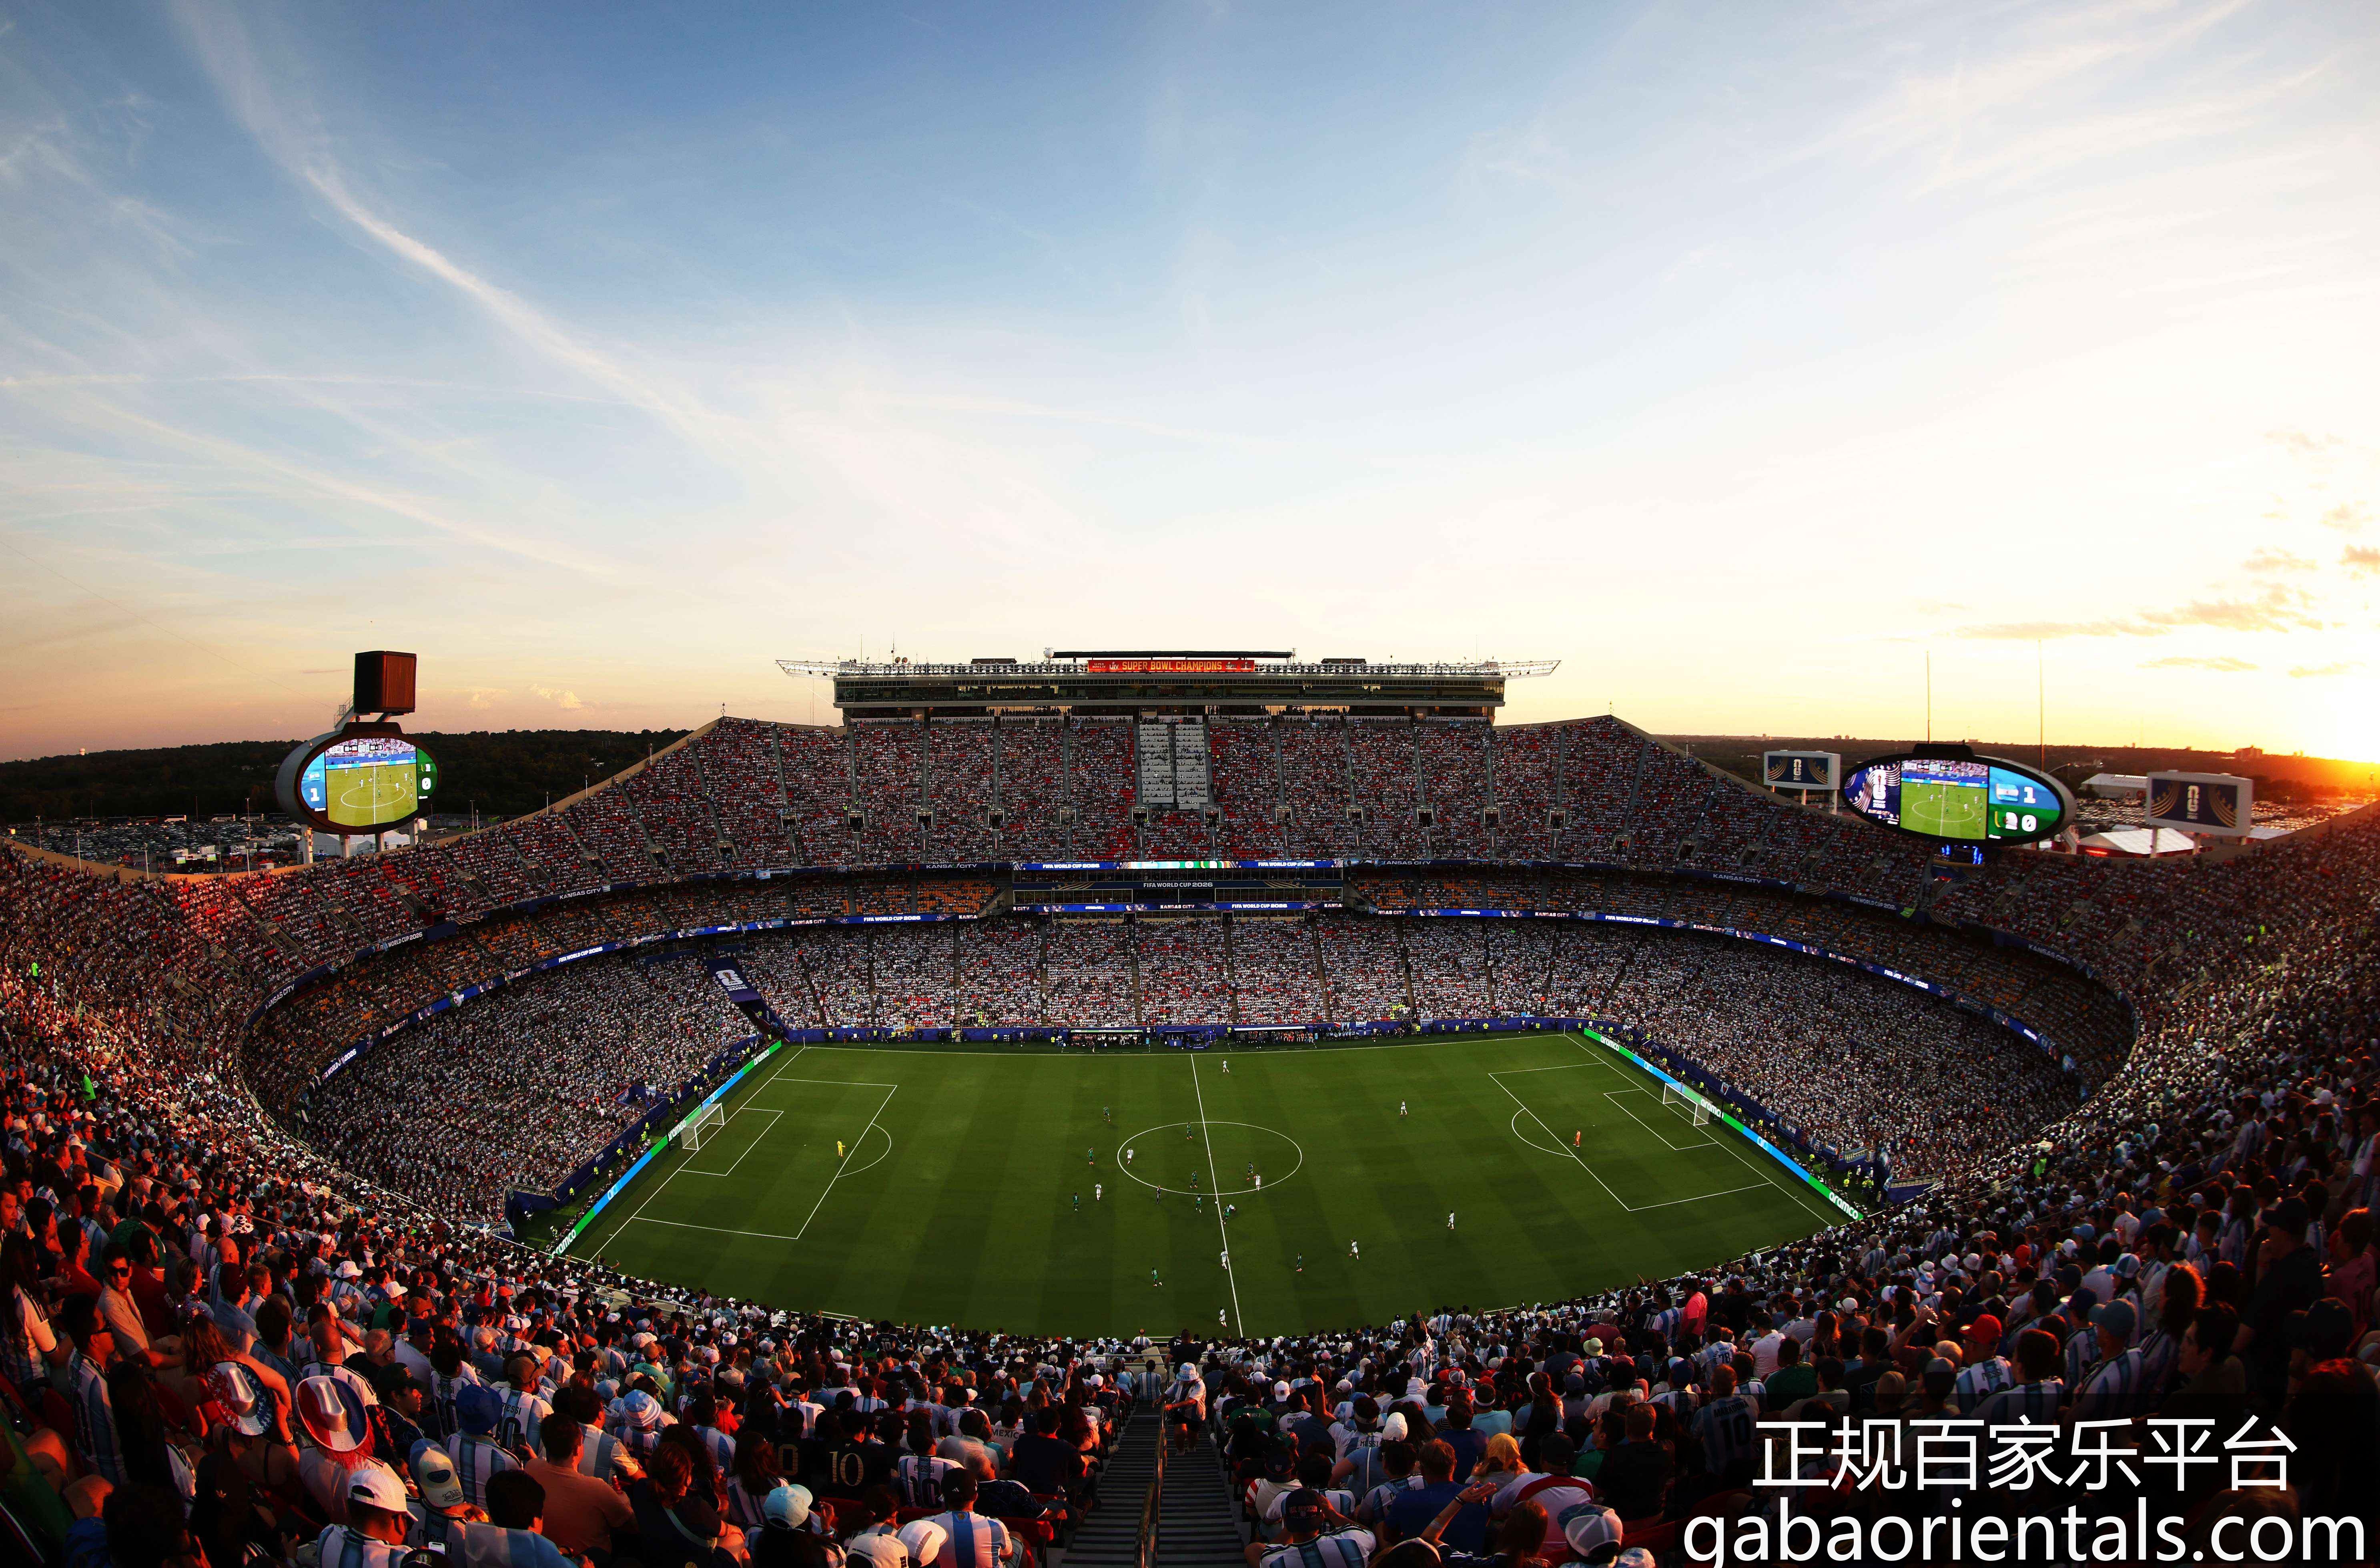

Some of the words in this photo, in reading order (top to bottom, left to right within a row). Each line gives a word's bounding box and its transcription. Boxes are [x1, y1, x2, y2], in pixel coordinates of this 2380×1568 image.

[1122, 661, 1147, 670] SUPER
[1151, 661, 1173, 670] BOWL
[1176, 661, 1222, 670] CHAMPIONS
[422, 777, 431, 790] 0
[310, 787, 320, 802] 1
[2023, 787, 2036, 804] 1
[2021, 815, 2037, 832] 0
[559, 891, 585, 899] KANSAS
[387, 940, 402, 948] WORLD
[409, 932, 423, 940] 2026
[567, 952, 581, 960] WORLD
[283, 984, 295, 996] CITY
[1600, 1036, 1620, 1051] aramco
[753, 1049, 770, 1066] aramco
[1700, 1098, 1724, 1119] aramco
[596, 1153, 604, 1162] FIFA
[1829, 1192, 1859, 1220] aramco
[880, 1341, 891, 1351] 10
[437, 1383, 454, 1394] MESSI
[502, 1403, 521, 1415] MESSI
[1714, 1401, 1749, 1417] MARADONA
[993, 1428, 1020, 1440] MEXIC
[1720, 1413, 1750, 1447] 10
[778, 1443, 799, 1476] 0
[829, 1450, 865, 1486] 10
[914, 1465, 934, 1474] MESSI
[910, 1476, 942, 1508] 10
